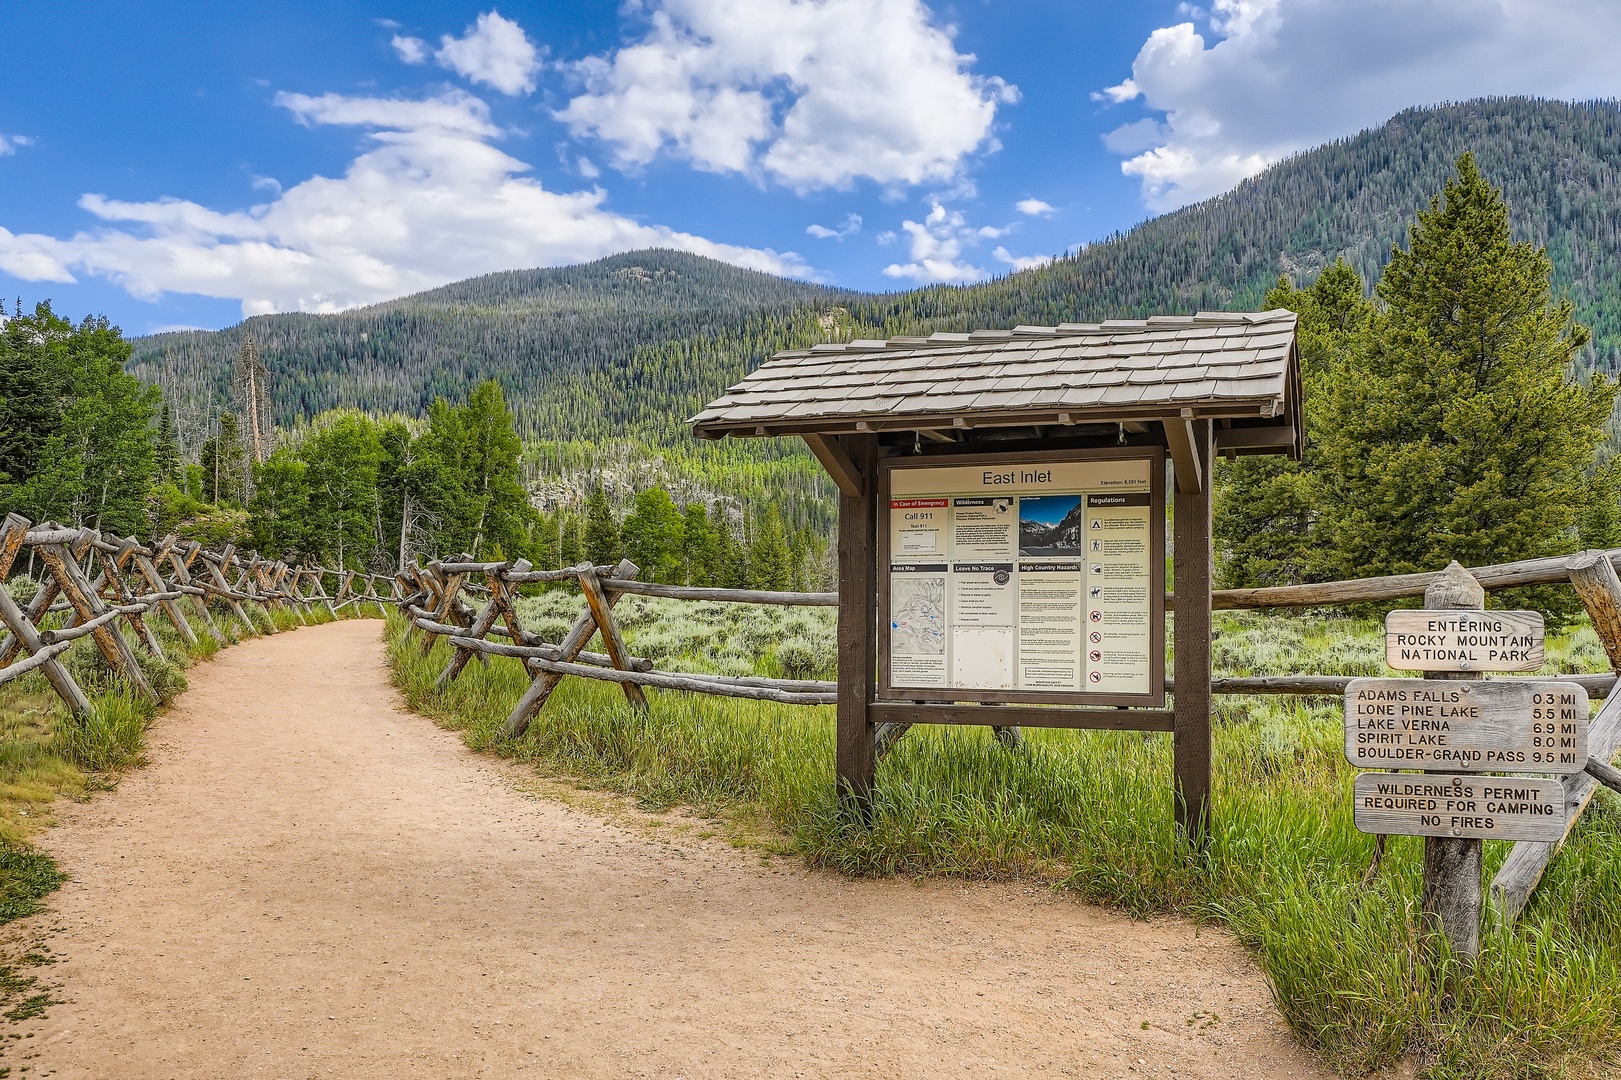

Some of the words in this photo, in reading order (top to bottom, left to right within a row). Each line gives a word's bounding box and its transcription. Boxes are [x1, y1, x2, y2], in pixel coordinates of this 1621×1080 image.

[983, 471, 1016, 484] East
[1020, 470, 1052, 484] Inlet
[1428, 620, 1502, 632] ENTERING
[1398, 634, 1446, 646] ROCKY
[1457, 636, 1534, 647] MOUNTAIN
[1401, 649, 1478, 661] NATIONAL
[1489, 650, 1530, 661] PARK
[1358, 690, 1407, 701] ADAMS
[1414, 691, 1460, 702] FALLS
[1532, 694, 1555, 705] 0.3
[1560, 694, 1576, 705] MI
[1358, 704, 1395, 716] LONE
[1401, 706, 1433, 716] PINE
[1440, 706, 1479, 718] LAKE
[1533, 708, 1555, 719] 5.5
[1560, 709, 1576, 720] MI
[1358, 719, 1395, 730] LAKE
[1402, 720, 1450, 731] VERNA
[1533, 723, 1555, 734] 6.9
[1560, 723, 1576, 734] MI
[1357, 733, 1402, 744] SPIRIT
[1409, 734, 1446, 746] LAKE
[1533, 737, 1555, 748] 8.0
[1560, 737, 1576, 748] MI
[1358, 748, 1481, 761] BOULDER-GRAND
[1487, 751, 1525, 762] PASS
[1532, 752, 1555, 763] 9.5
[1560, 752, 1576, 764] MI
[1377, 784, 1474, 798] WILDERNESS
[1484, 788, 1540, 800] PERMIT
[1364, 798, 1436, 811] REQUIRED
[1446, 800, 1476, 812] FOR
[1486, 802, 1553, 815] CAMPING
[1421, 815, 1441, 826] NO
[1451, 816, 1494, 829] FIRES
